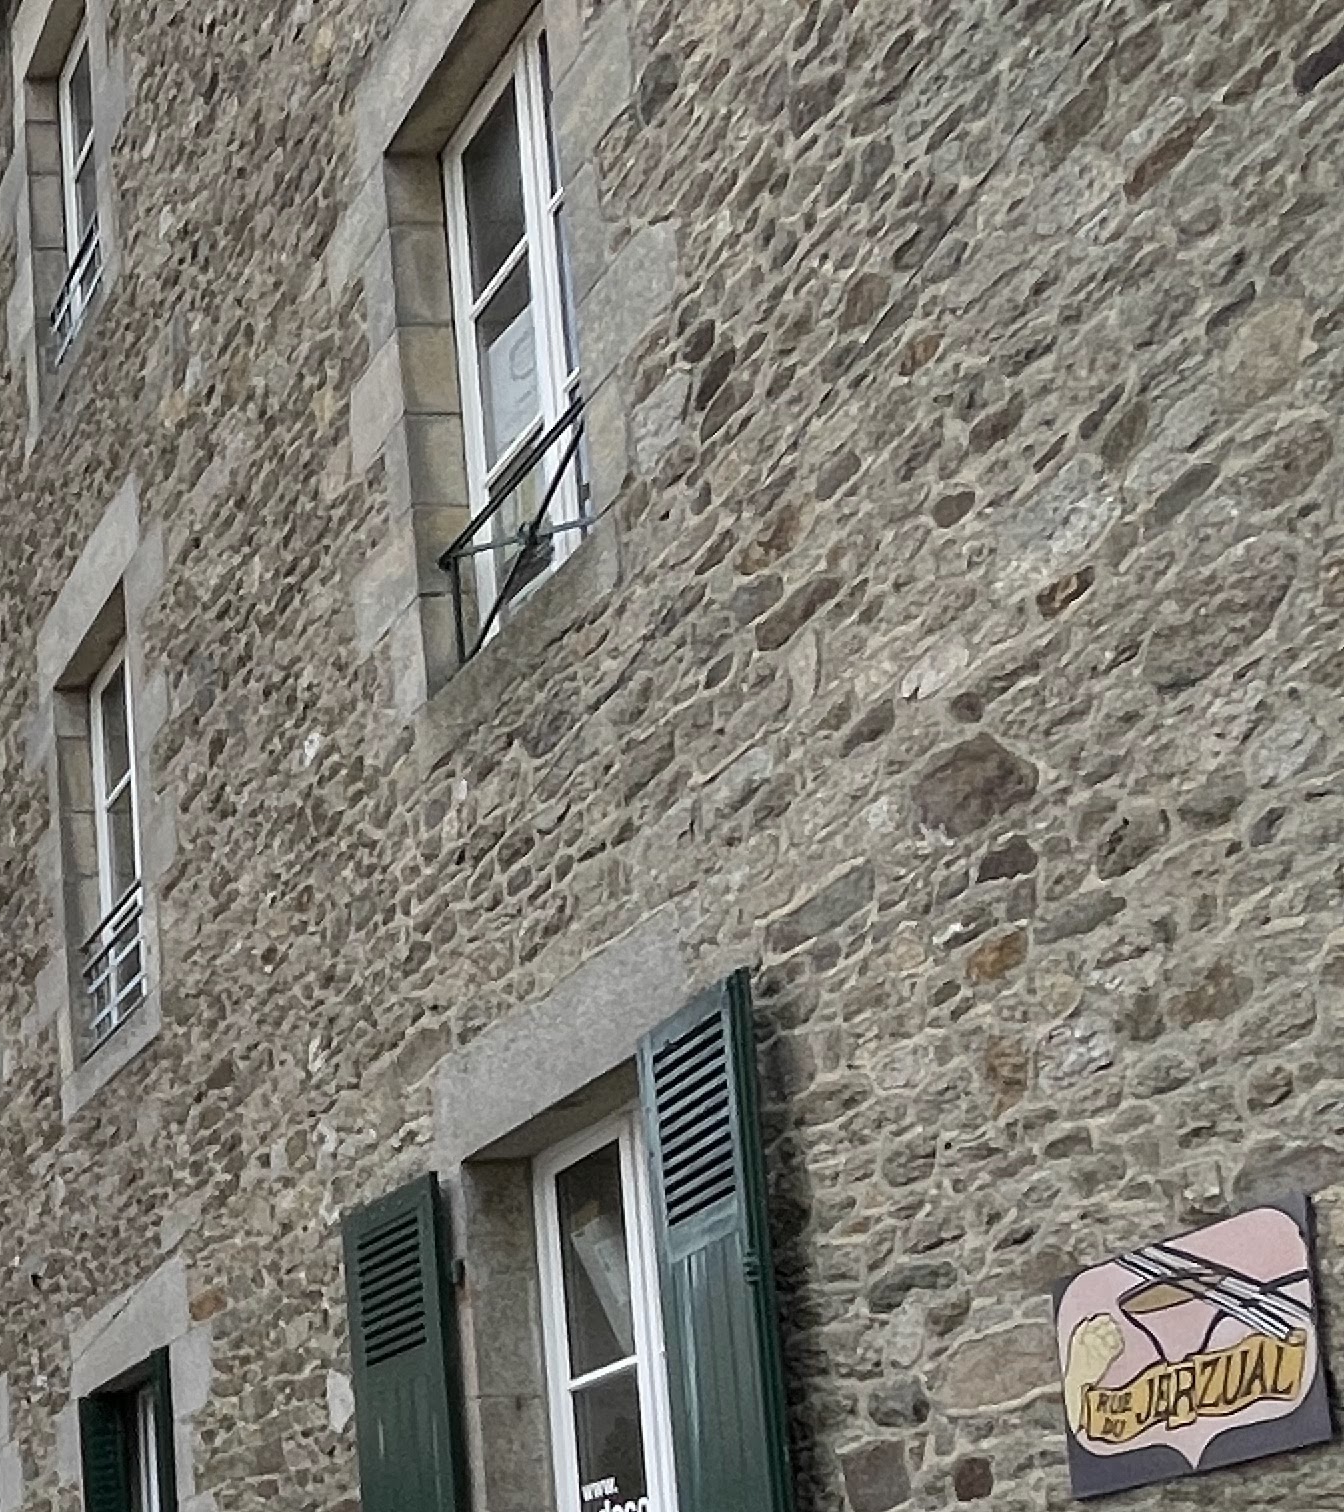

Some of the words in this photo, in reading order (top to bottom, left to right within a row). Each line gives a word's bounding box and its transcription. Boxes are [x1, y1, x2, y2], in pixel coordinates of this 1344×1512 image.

[1095, 1391, 1133, 1414] RUE
[1134, 1339, 1295, 1424] JERZUAL
[1100, 1416, 1126, 1438] DU
[582, 1476, 619, 1502] www.
